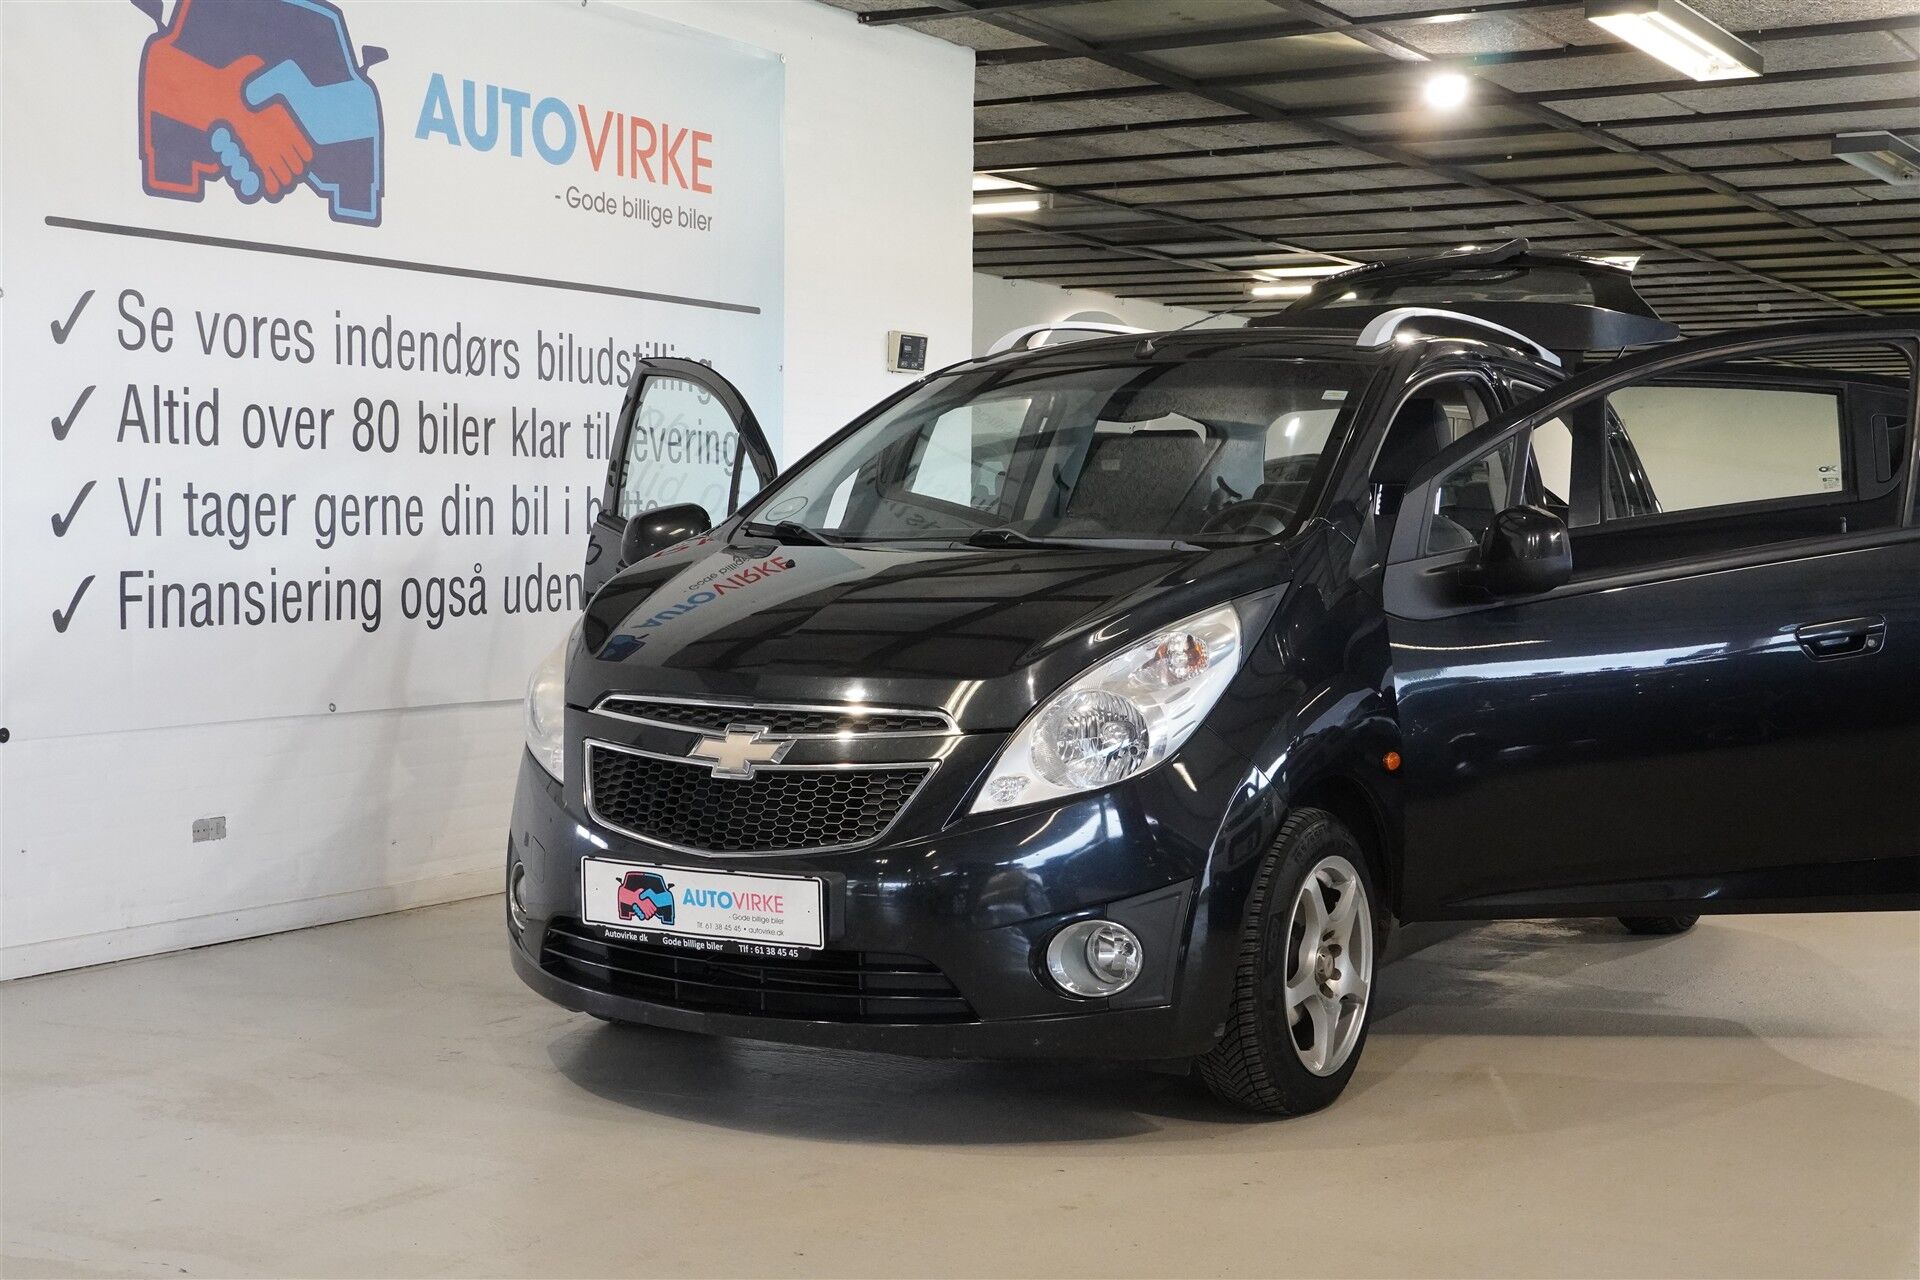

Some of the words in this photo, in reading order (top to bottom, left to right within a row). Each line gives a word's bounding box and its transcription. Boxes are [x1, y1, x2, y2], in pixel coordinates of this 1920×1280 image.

[415, 72, 712, 194] AUTOVIRKE
[566, 185, 617, 215] Gode
[623, 195, 673, 228] billige
[678, 206, 712, 231] biler
[118, 289, 173, 352] Se
[196, 311, 314, 363] vores
[336, 310, 519, 379] indendørs
[117, 384, 218, 446] Altid
[243, 404, 334, 449] over
[353, 398, 399, 453] 80
[419, 401, 495, 456] biler
[512, 407, 571, 458] klar
[584, 412, 610, 460] til
[631, 418, 738, 475] evering
[118, 478, 161, 536] Vi
[183, 484, 296, 550] tager
[315, 494, 423, 549] gerne
[442, 483, 493, 536] din
[512, 485, 548, 536] bil
[565, 486, 569, 534] i
[120, 567, 381, 633] Finansiering
[401, 563, 487, 629] også
[504, 563, 584, 613] uden
[683, 888, 784, 913] AUTOVIRKE
[705, 922, 713, 930] 61
[715, 923, 722, 931] 38
[724, 924, 732, 932] 45
[734, 925, 742, 933] 45
[732, 914, 751, 922] Gode
[752, 916, 769, 925] billige
[662, 937, 682, 947] Gode
[684, 940, 705, 951] billige
[706, 943, 723, 951] biler
[754, 946, 764, 955] 61
[766, 947, 776, 956] 38
[777, 948, 787, 957] 45
[788, 949, 798, 958] 45
